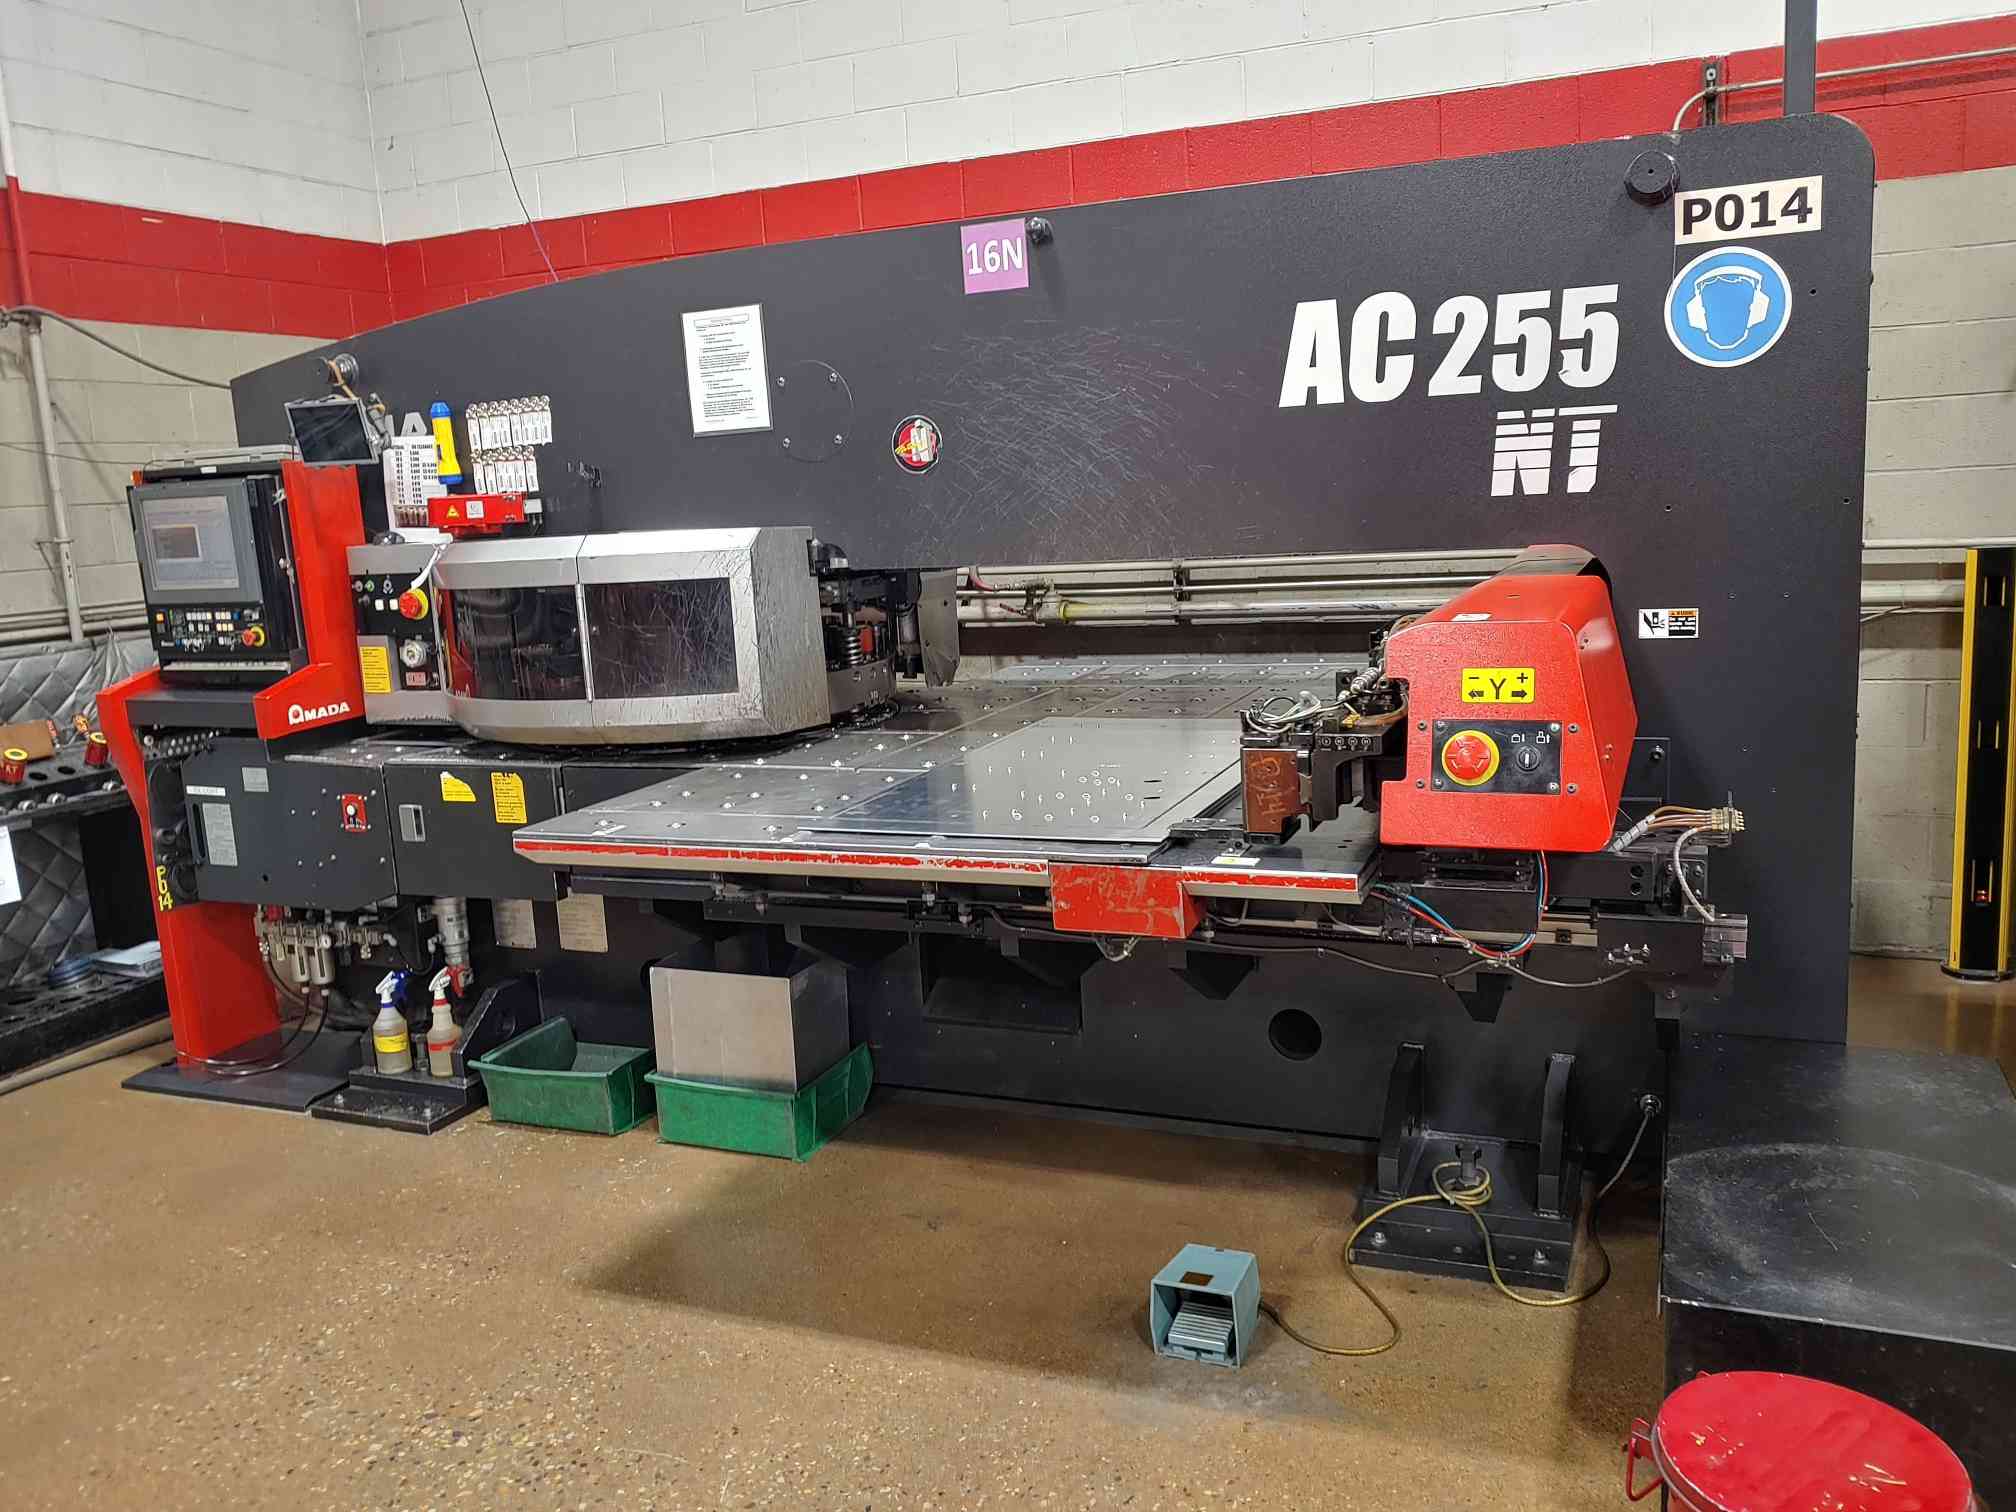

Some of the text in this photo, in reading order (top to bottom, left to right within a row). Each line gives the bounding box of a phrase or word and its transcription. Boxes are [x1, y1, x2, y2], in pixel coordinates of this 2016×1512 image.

[1681, 186, 1813, 236] P014
[966, 236, 1024, 275] 16N
[288, 701, 351, 725] AMADA
